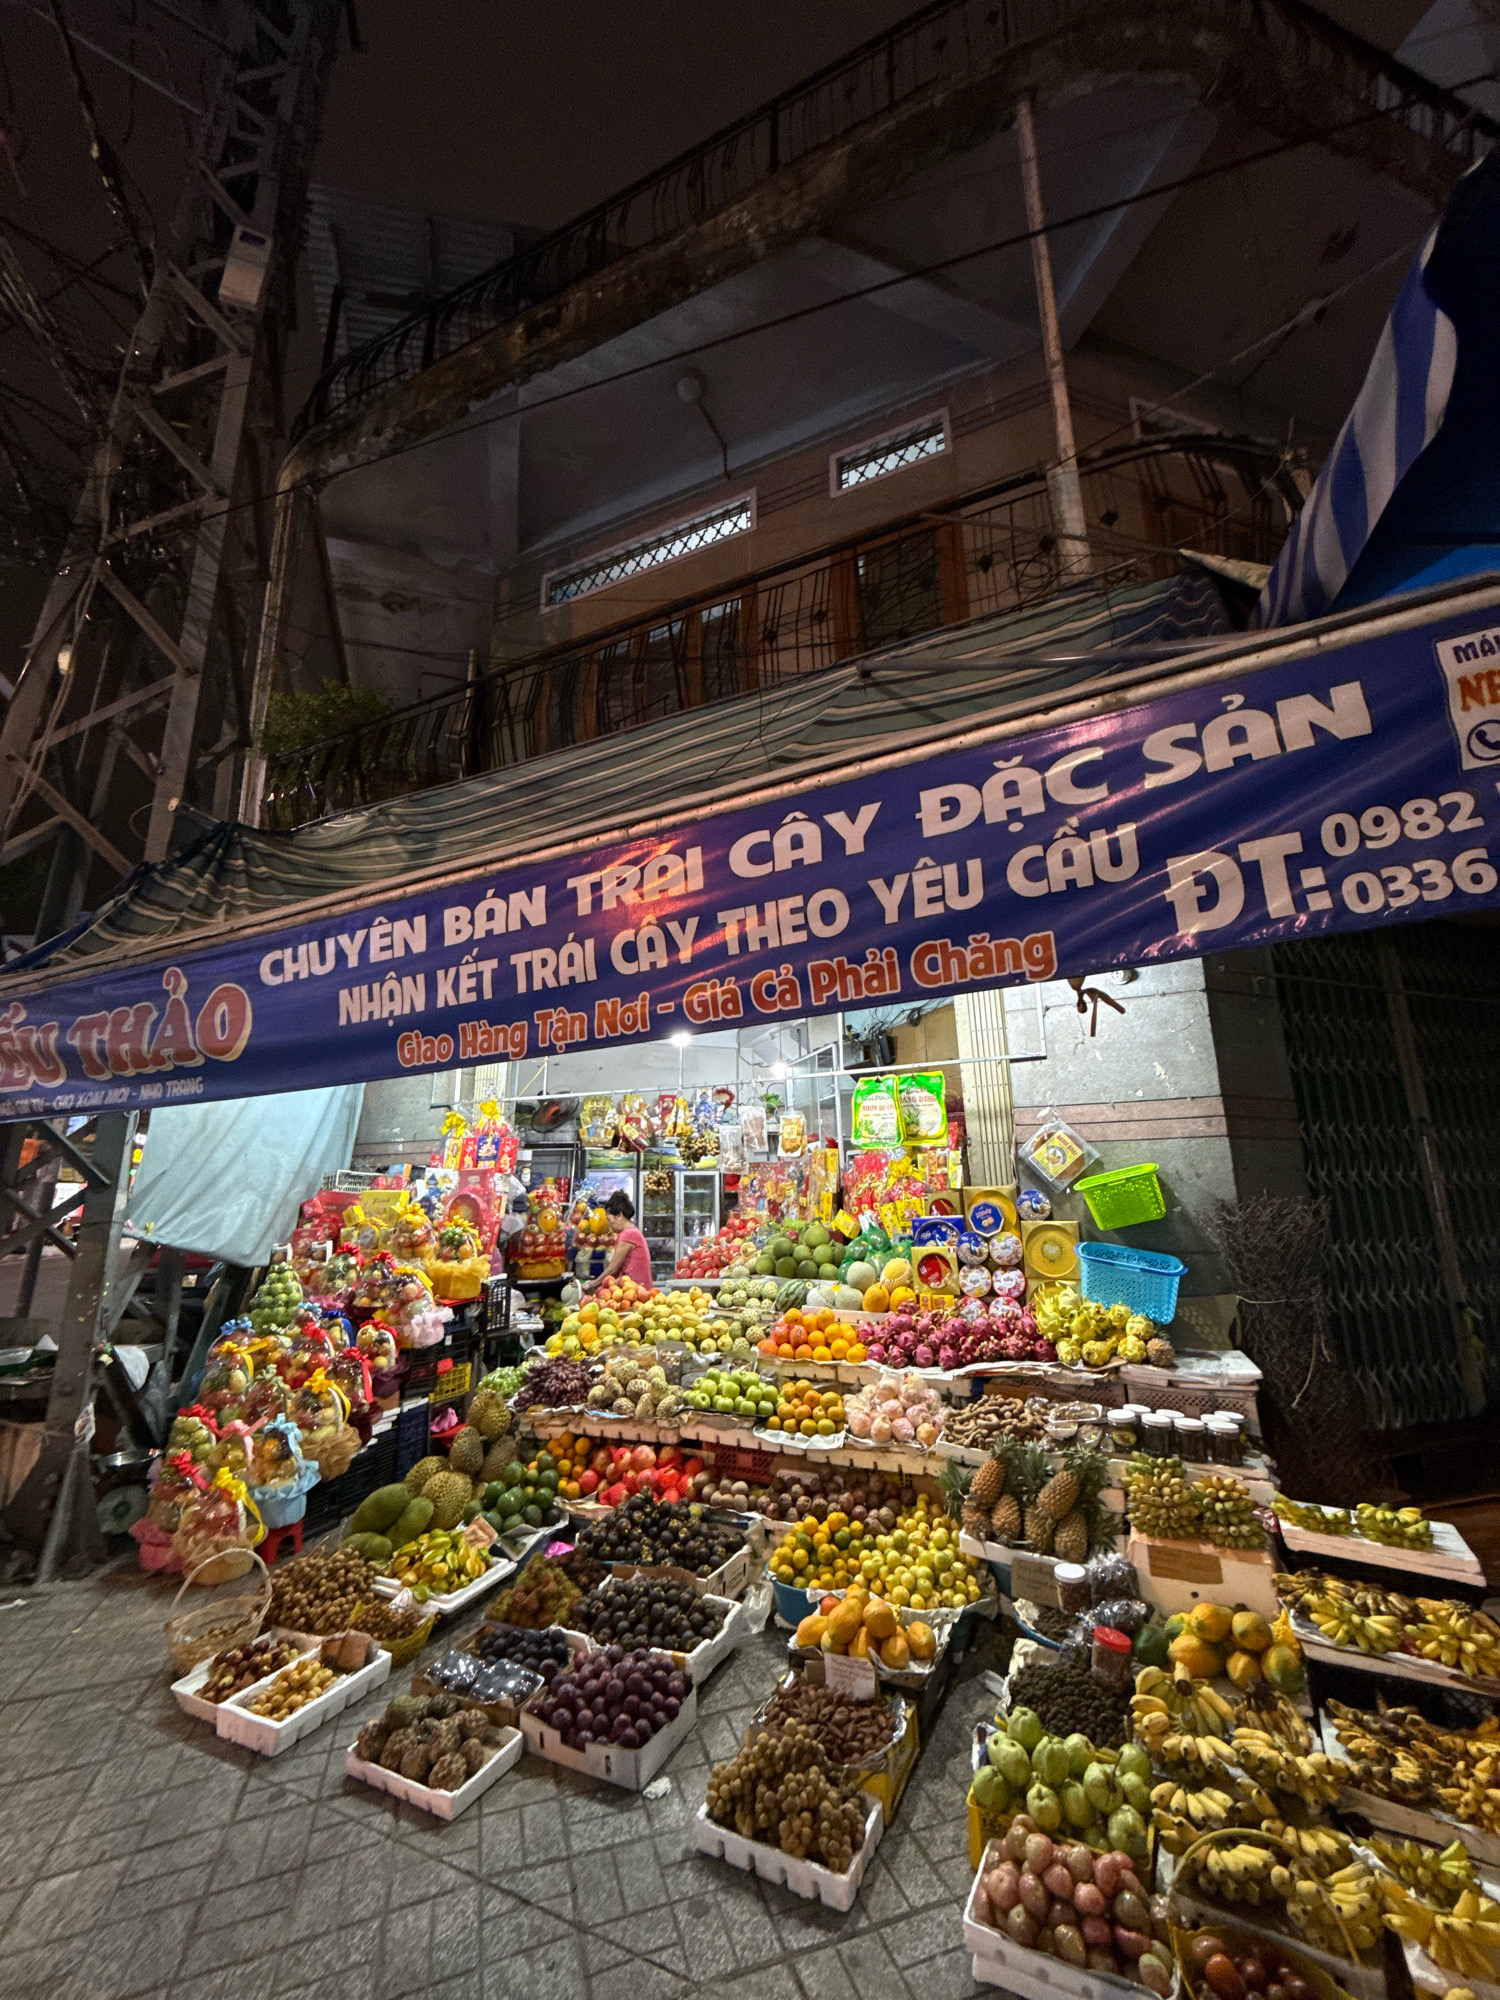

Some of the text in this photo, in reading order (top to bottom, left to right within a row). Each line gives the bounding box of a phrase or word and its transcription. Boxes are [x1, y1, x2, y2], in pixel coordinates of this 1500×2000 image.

[259, 681, 1373, 986] CHUYÊN BÁN TRÁI CÂY ĐẶC SẢN
[1164, 791, 1485, 936] ĐT: 0982
[1341, 847, 1499, 914] 0336
[339, 816, 1140, 1027] NHẬN KẾT TRÁI CÂY THEO YÊU CẦU
[67, 966, 253, 1080] THẢO
[398, 1030, 453, 1067] Giao
[459, 1018, 527, 1060] Hàng
[534, 1006, 587, 1054] Tận
[594, 991, 650, 1038] Nơi
[683, 977, 743, 1024] Giá
[750, 957, 802, 1013] Cả
[809, 946, 901, 1007] Phải
[911, 930, 1057, 988] Chăng
